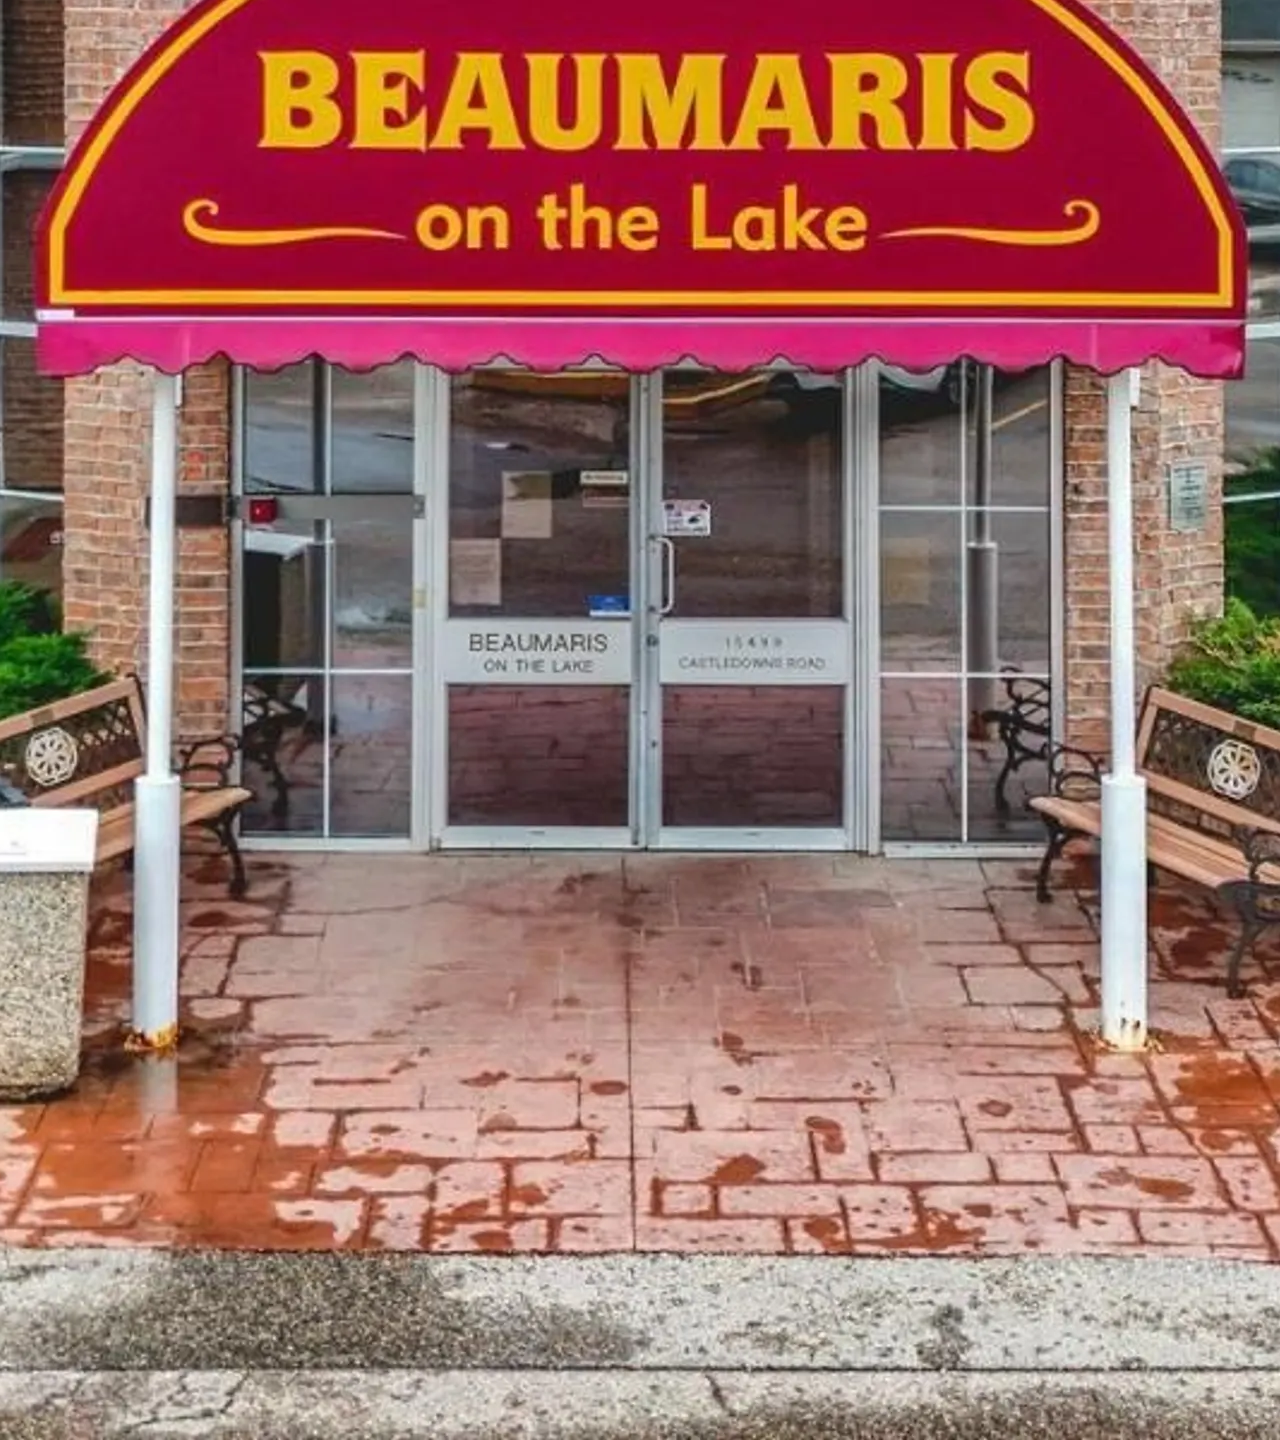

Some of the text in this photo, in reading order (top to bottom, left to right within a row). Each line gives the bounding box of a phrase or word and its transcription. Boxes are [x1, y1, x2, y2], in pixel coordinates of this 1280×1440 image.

[258, 50, 1034, 152] BEAUMARIS
[416, 183, 868, 251] on the Lake
[469, 633, 608, 653] BEAUMARIS
[483, 659, 594, 674] ON THE LAKE
[785, 656, 828, 671] ROAD
